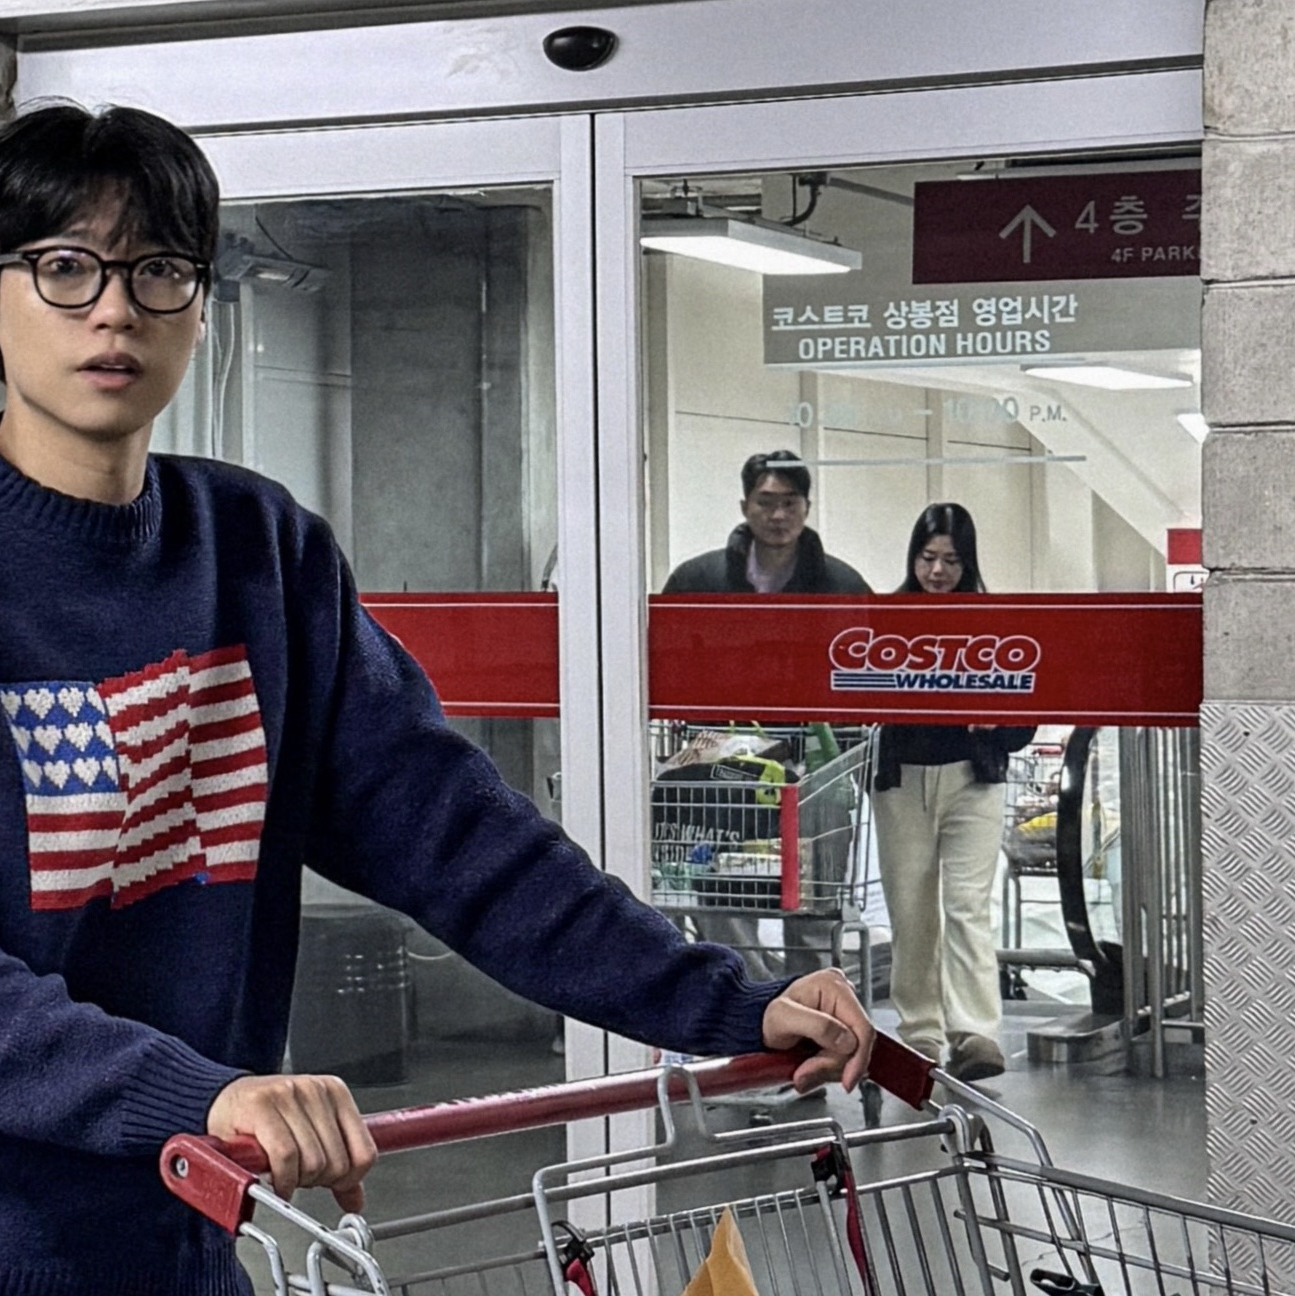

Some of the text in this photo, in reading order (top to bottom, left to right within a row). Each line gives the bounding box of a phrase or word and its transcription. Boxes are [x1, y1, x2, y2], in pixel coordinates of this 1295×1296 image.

[1111, 246, 1201, 263] 4F PARK
[771, 294, 1078, 331] 코스트코 상봉점 영업시간
[798, 330, 1051, 360] OPERATION HOURS
[1029, 404, 1067, 422] P.M.
[829, 627, 1041, 672] COSTCO
[895, 673, 1033, 690] WHOLESALE
